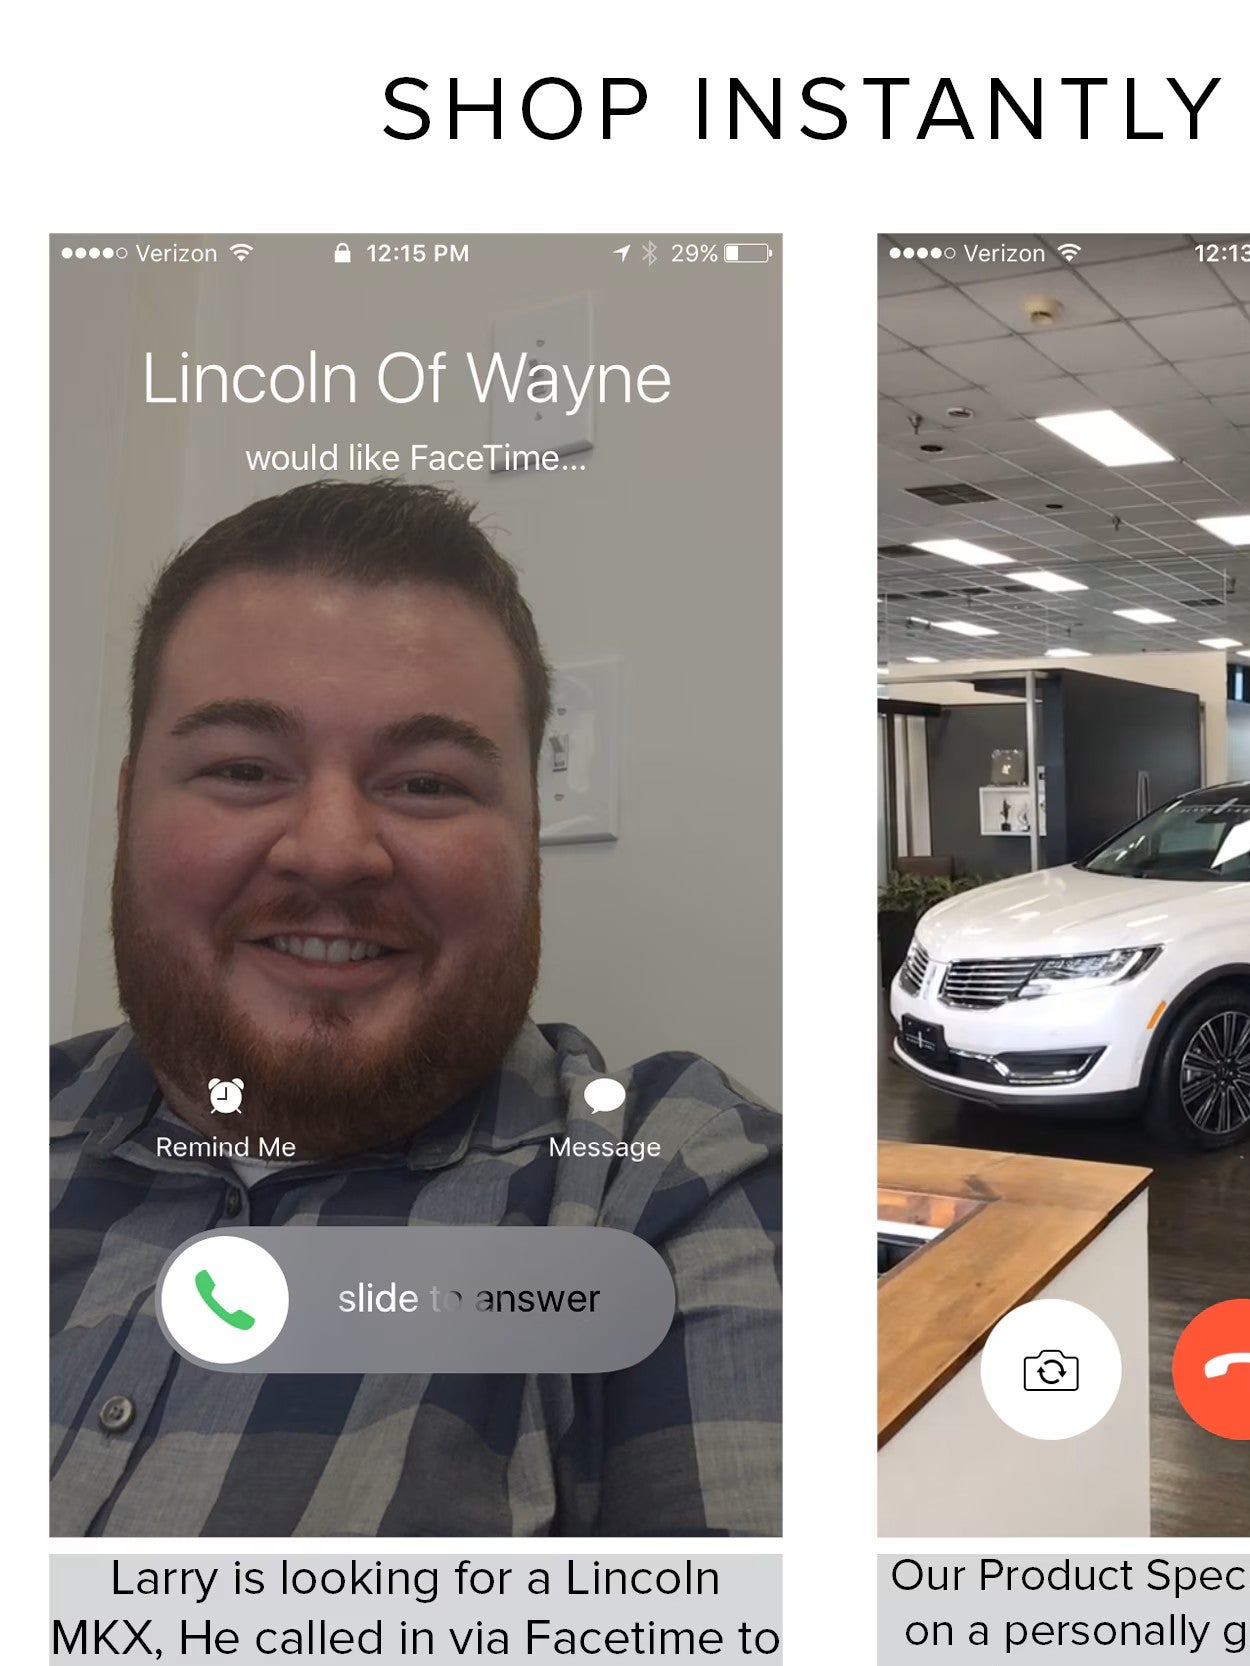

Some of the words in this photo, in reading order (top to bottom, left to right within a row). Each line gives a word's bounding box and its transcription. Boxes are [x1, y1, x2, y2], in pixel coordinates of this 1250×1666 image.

[135, 243, 217, 262] Verizon
[366, 244, 426, 263] 12:15
[434, 244, 469, 262] PM
[671, 243, 718, 263] 29%
[963, 243, 1045, 263] Verizon
[145, 349, 356, 404] Lincoln
[378, 351, 447, 404] Of
[466, 351, 671, 416] Wayne
[245, 443, 338, 471] would
[349, 442, 400, 471] like
[411, 442, 586, 471] FaceTime...
[157, 1136, 249, 1157] Remind
[259, 1137, 296, 1157] Me
[550, 1136, 661, 1162] Message
[338, 1282, 419, 1314] slide
[429, 1284, 463, 1314] to
[475, 1289, 601, 1314] answer
